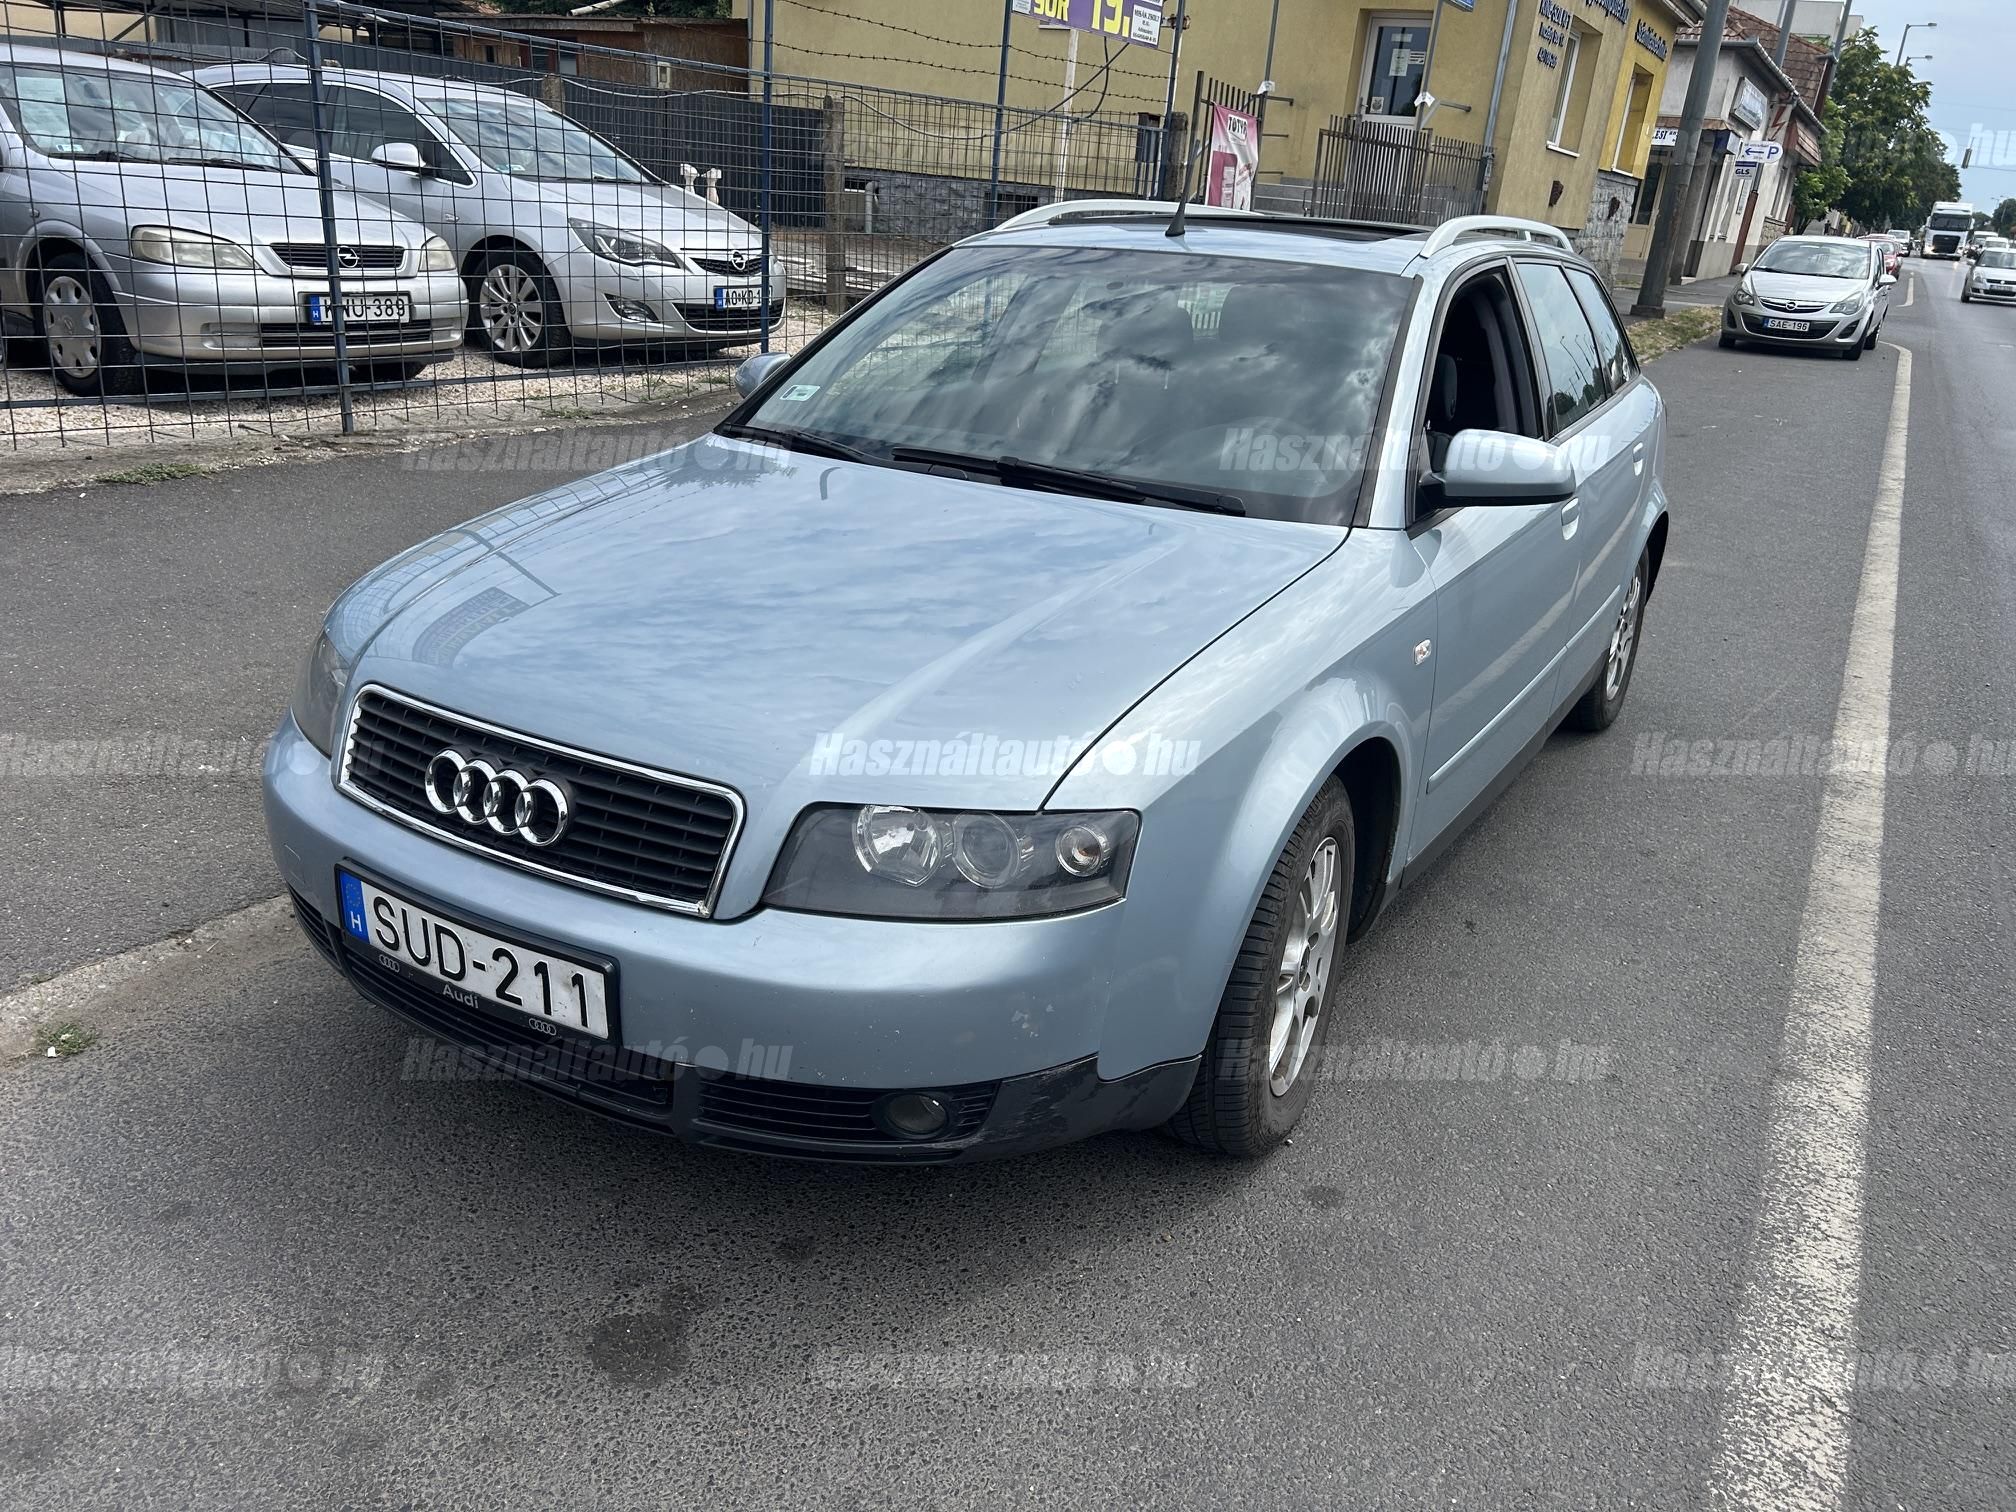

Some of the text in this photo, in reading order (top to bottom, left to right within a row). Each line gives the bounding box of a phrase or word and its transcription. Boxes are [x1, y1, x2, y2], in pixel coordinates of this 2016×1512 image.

[1767, 146, 1779, 159] P
[1769, 319, 1808, 331] SAE-196
[350, 911, 363, 932] H
[373, 896, 589, 1029] SUD-211
[443, 985, 479, 1009] Audi
